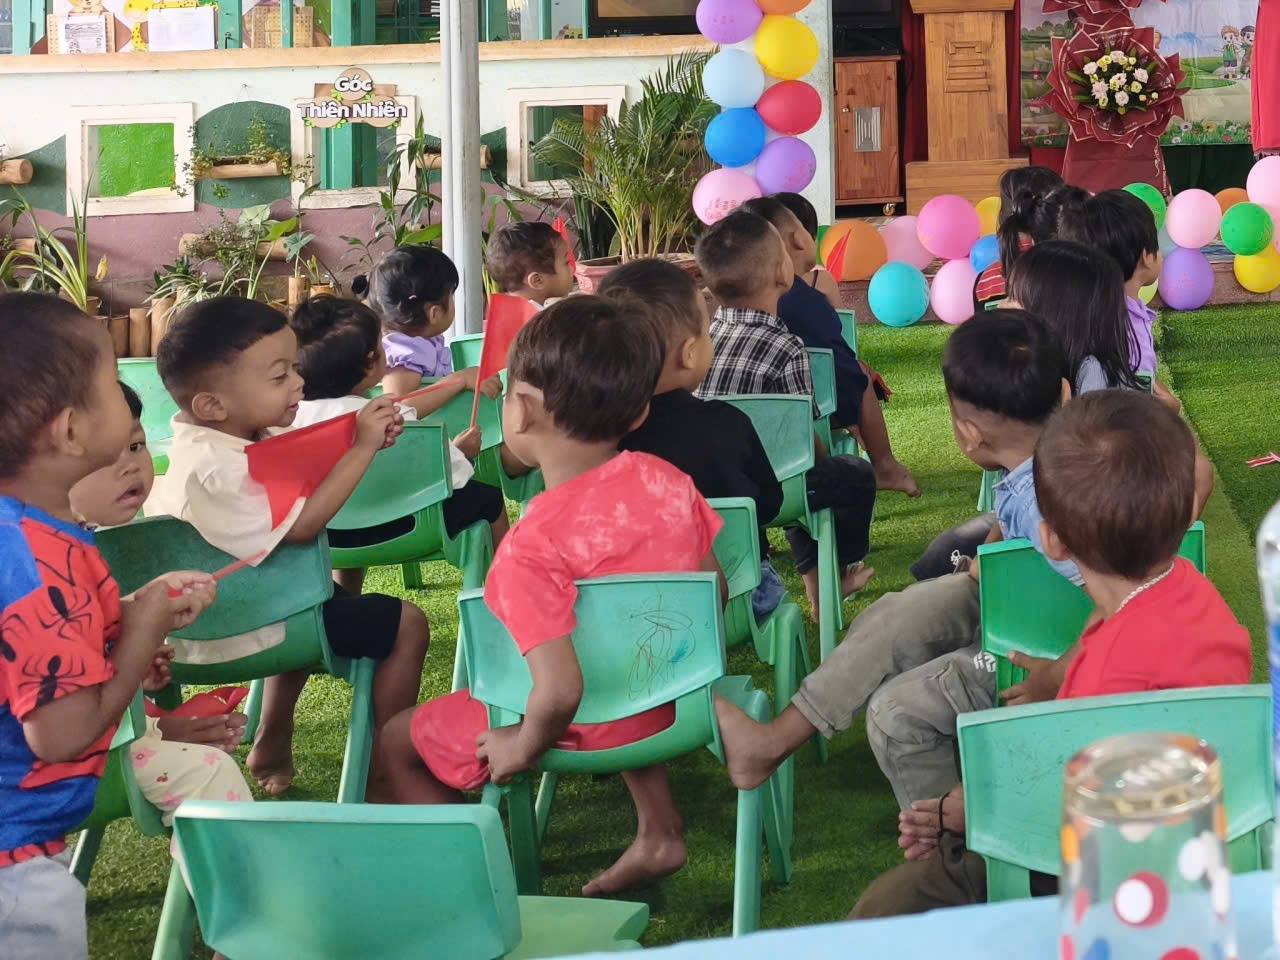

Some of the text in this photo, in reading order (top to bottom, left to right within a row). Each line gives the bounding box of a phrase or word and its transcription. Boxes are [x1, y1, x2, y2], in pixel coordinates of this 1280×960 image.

[334, 74, 373, 93] Góc
[297, 100, 408, 118] Thiên Nhiên
